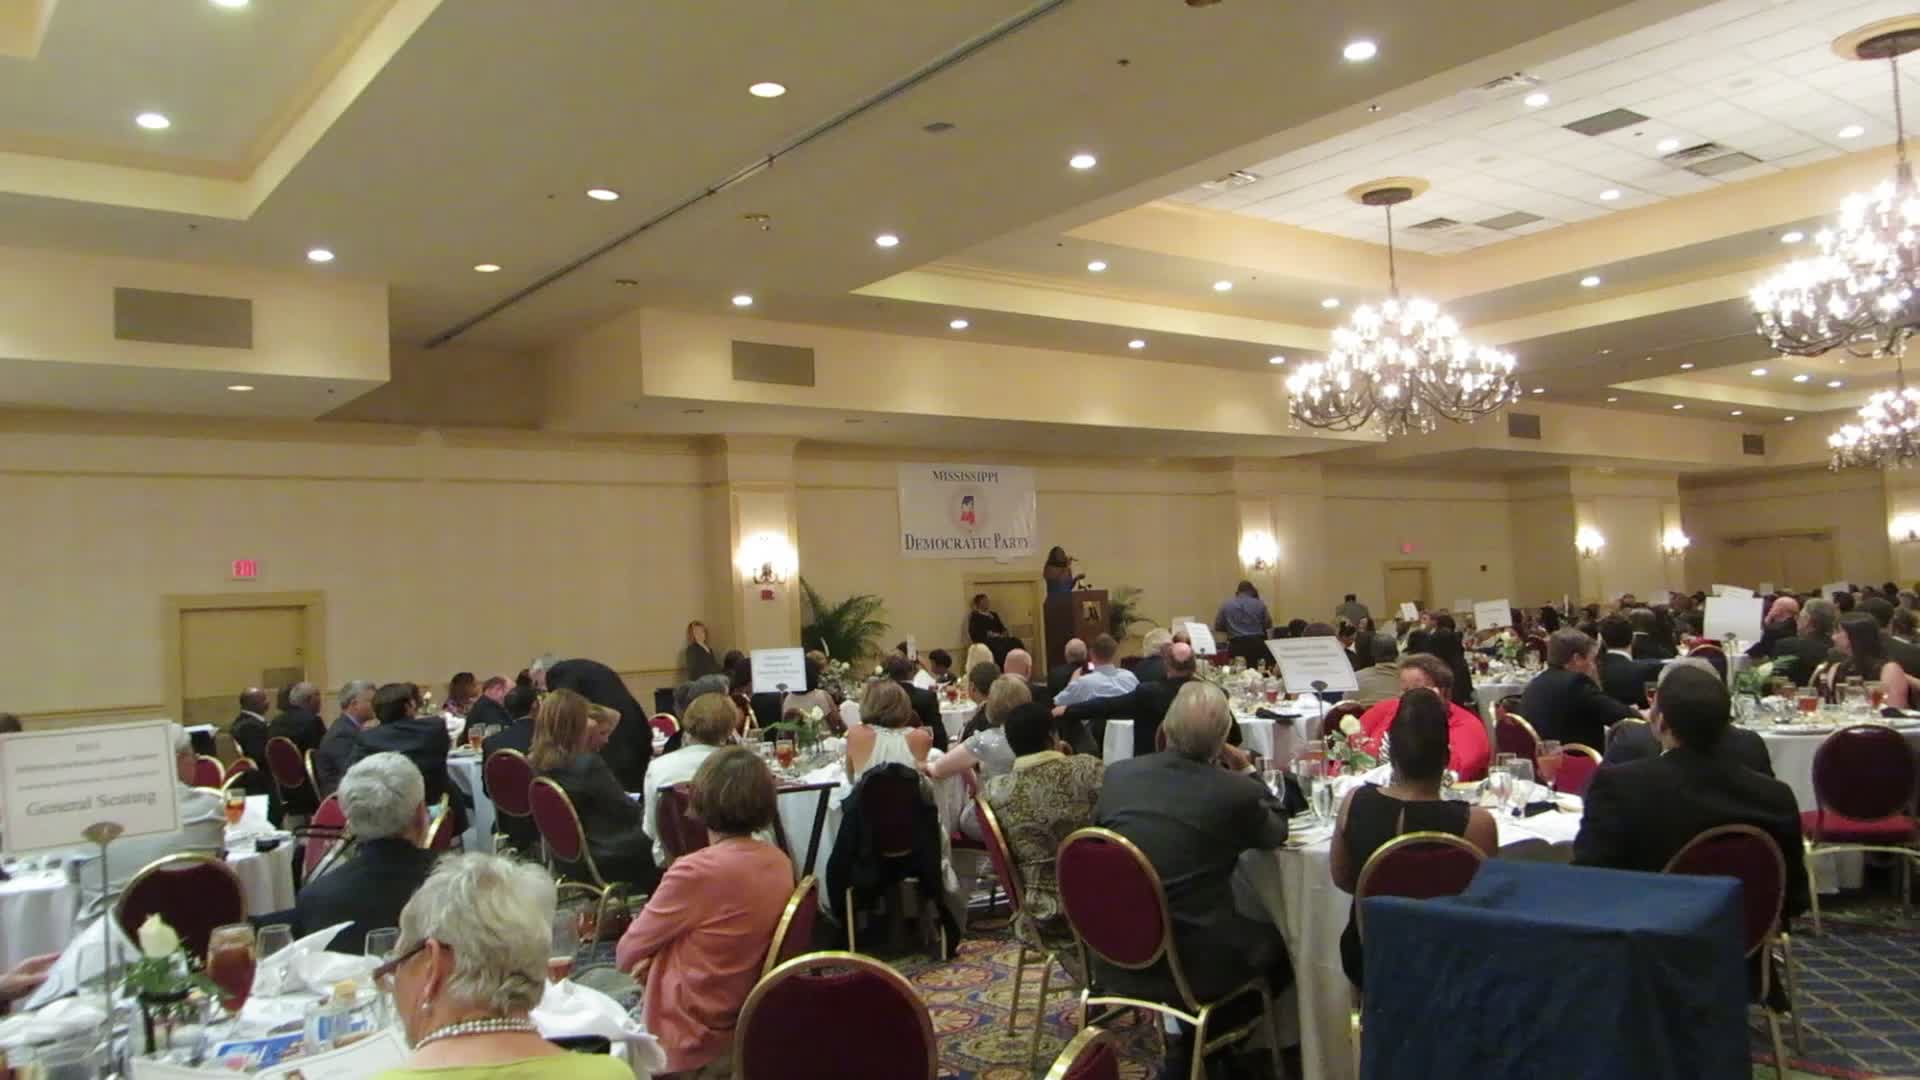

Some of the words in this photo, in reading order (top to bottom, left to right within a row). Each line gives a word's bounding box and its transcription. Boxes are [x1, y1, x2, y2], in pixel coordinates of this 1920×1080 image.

[905, 533, 991, 550] DEMOCRATIC
[993, 532, 1030, 549] PARTY
[26, 796, 92, 816] General
[96, 792, 157, 809] Seating
